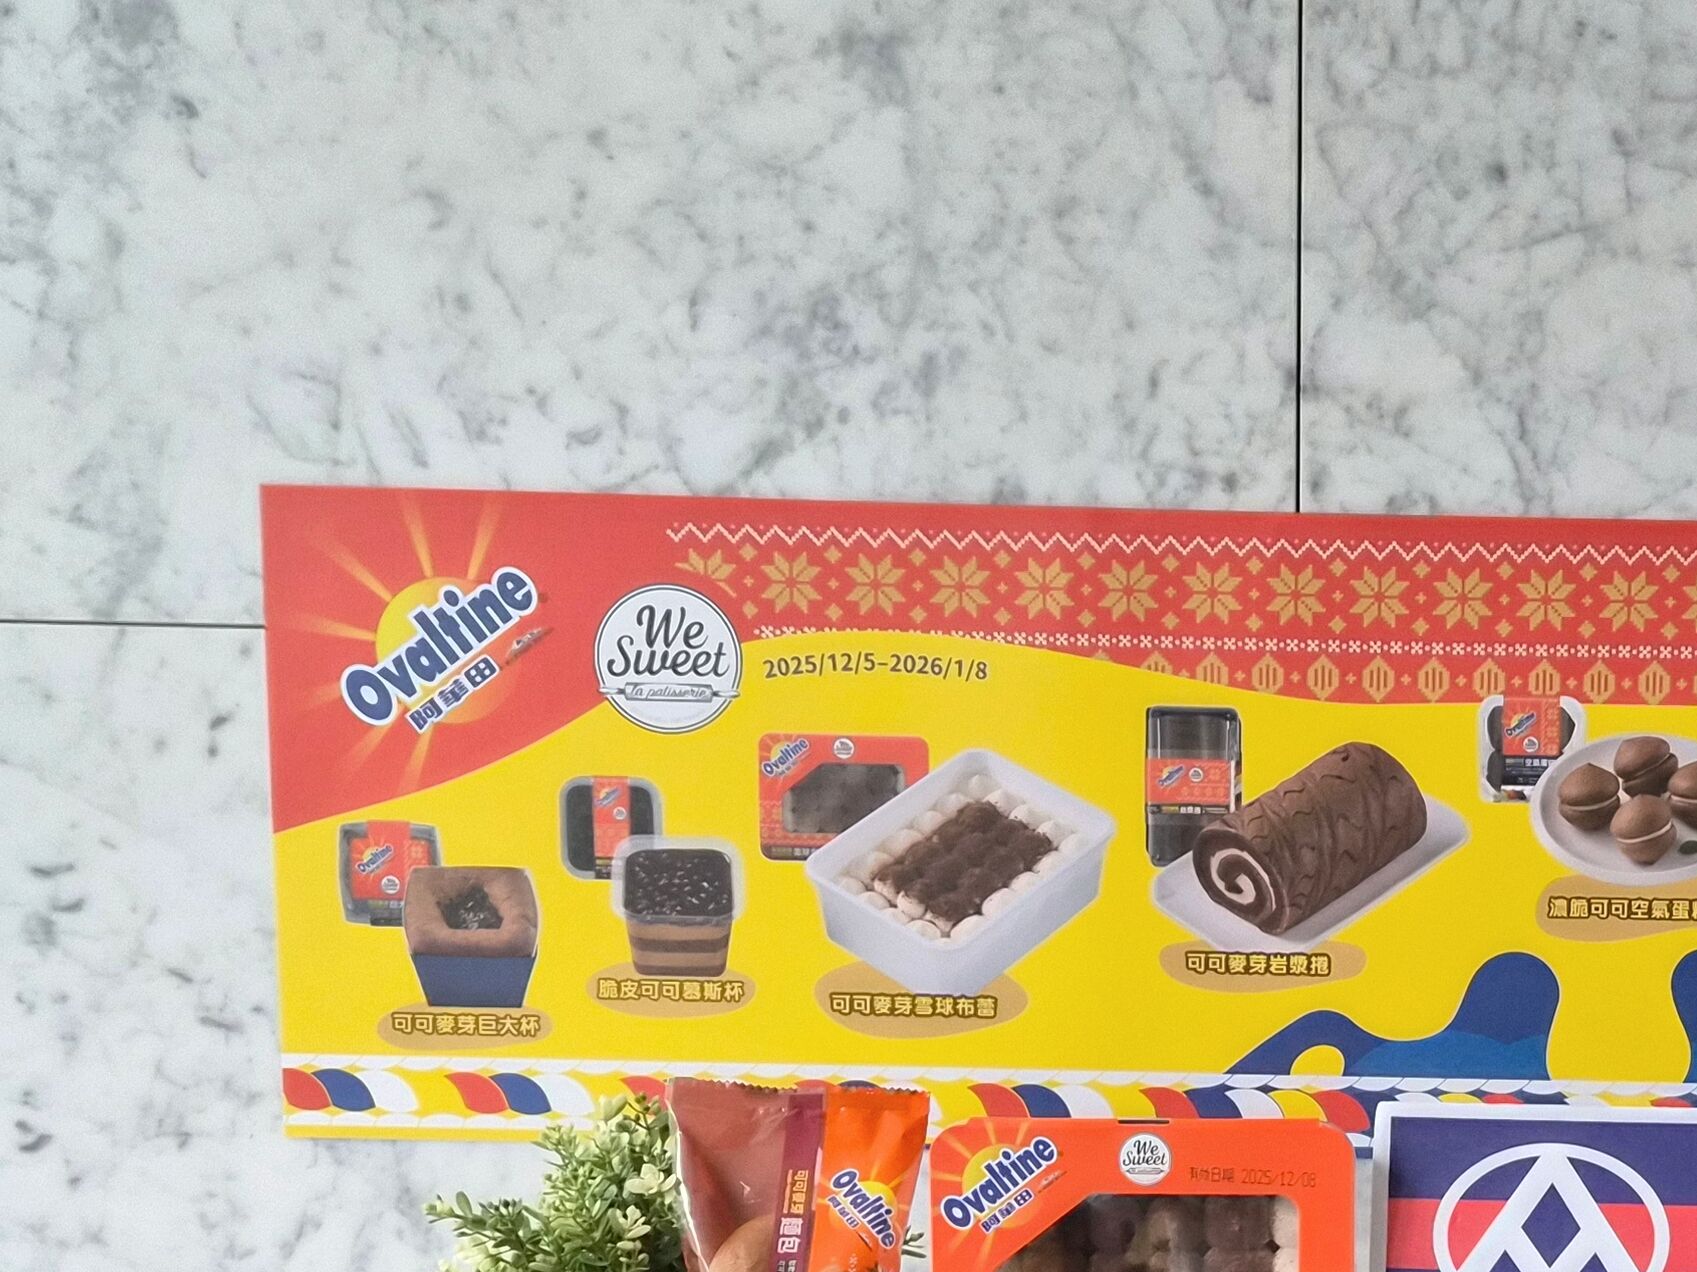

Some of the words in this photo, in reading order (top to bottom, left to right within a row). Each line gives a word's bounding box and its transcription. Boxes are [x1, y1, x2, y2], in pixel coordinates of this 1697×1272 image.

[635, 604, 708, 651] We
[344, 568, 535, 723] Ovaltine
[607, 634, 730, 679] Sweet
[408, 656, 499, 732] 阿華田
[1186, 951, 1333, 977] 可可麥芽岩漿捲
[598, 978, 745, 1004] 脆皮可可慕斯杯
[830, 993, 999, 1019] 可可麥芽雪球布蕾
[392, 1012, 541, 1038] 可可麥芽巨大杯
[1122, 1151, 1169, 1168] Sweet
[1133, 1138, 1158, 1157] We
[943, 1138, 1057, 1228] Ovaltine
[832, 1170, 895, 1248] Ovaltine
